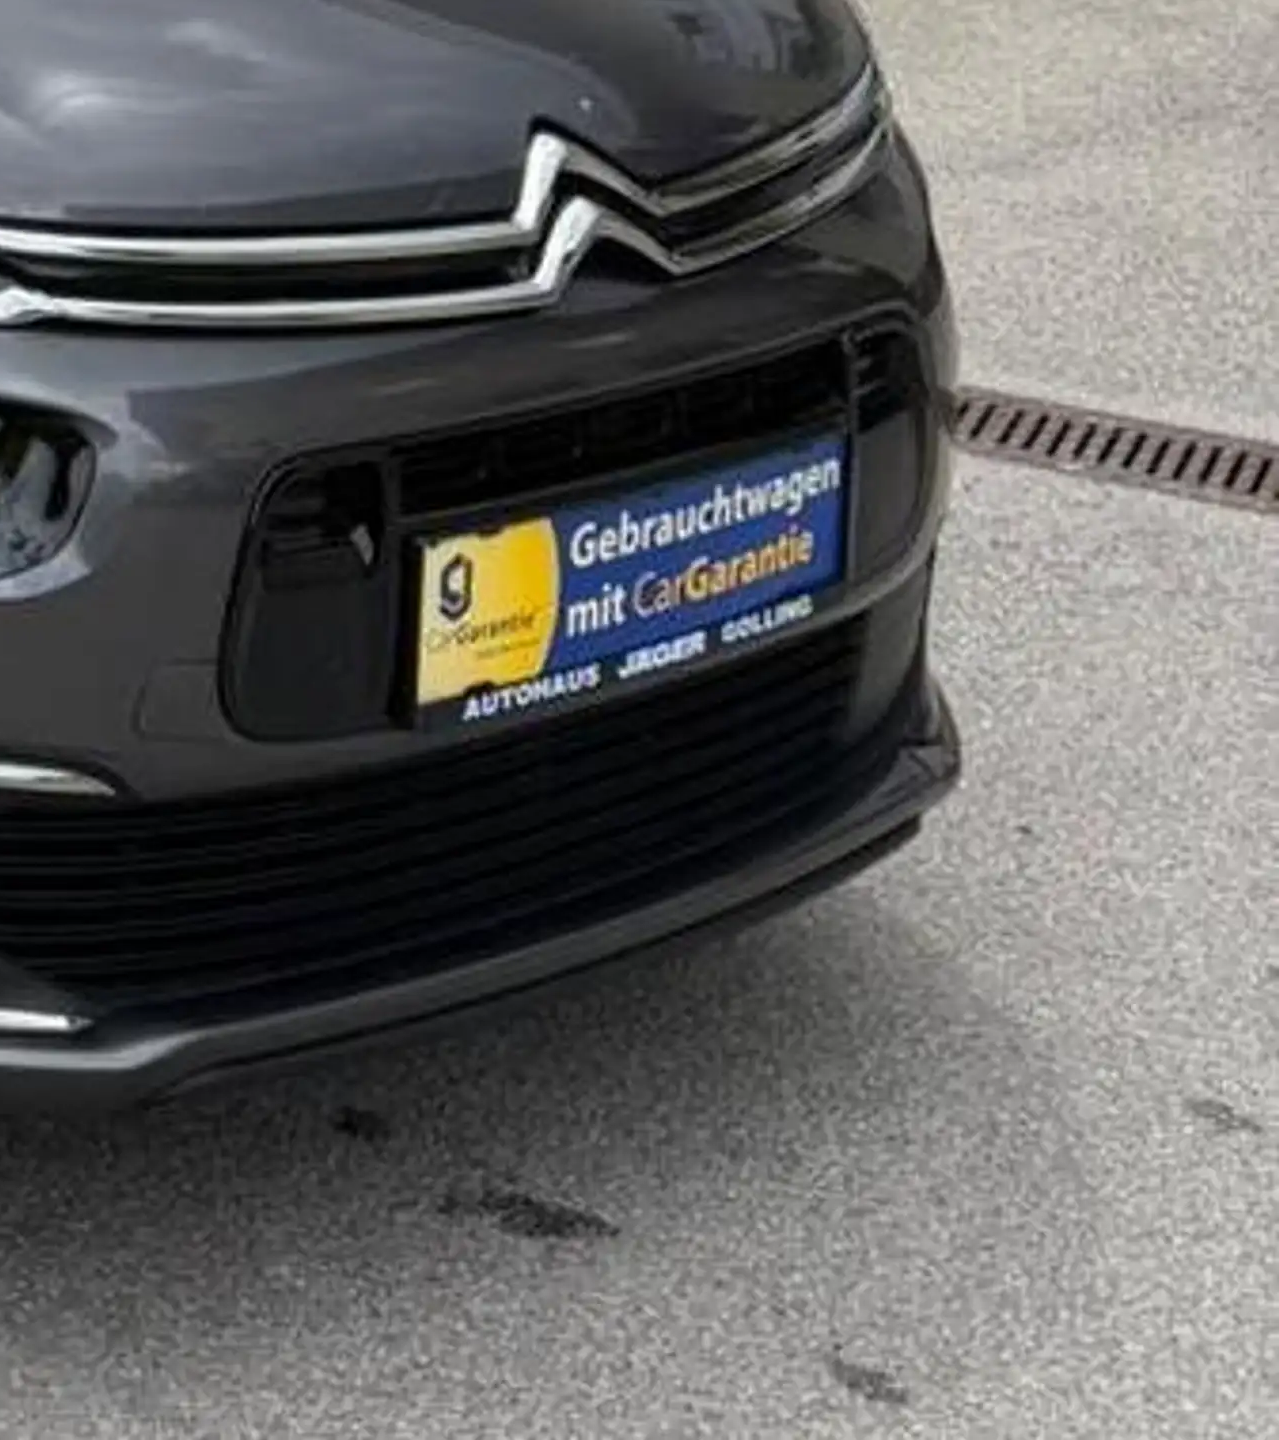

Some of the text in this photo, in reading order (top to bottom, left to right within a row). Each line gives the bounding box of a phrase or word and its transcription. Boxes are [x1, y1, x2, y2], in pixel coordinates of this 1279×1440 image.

[569, 458, 841, 569] Gebrauchtwagen
[566, 524, 814, 638] mit CarGarantie
[462, 662, 601, 722] AUTOHAUS
